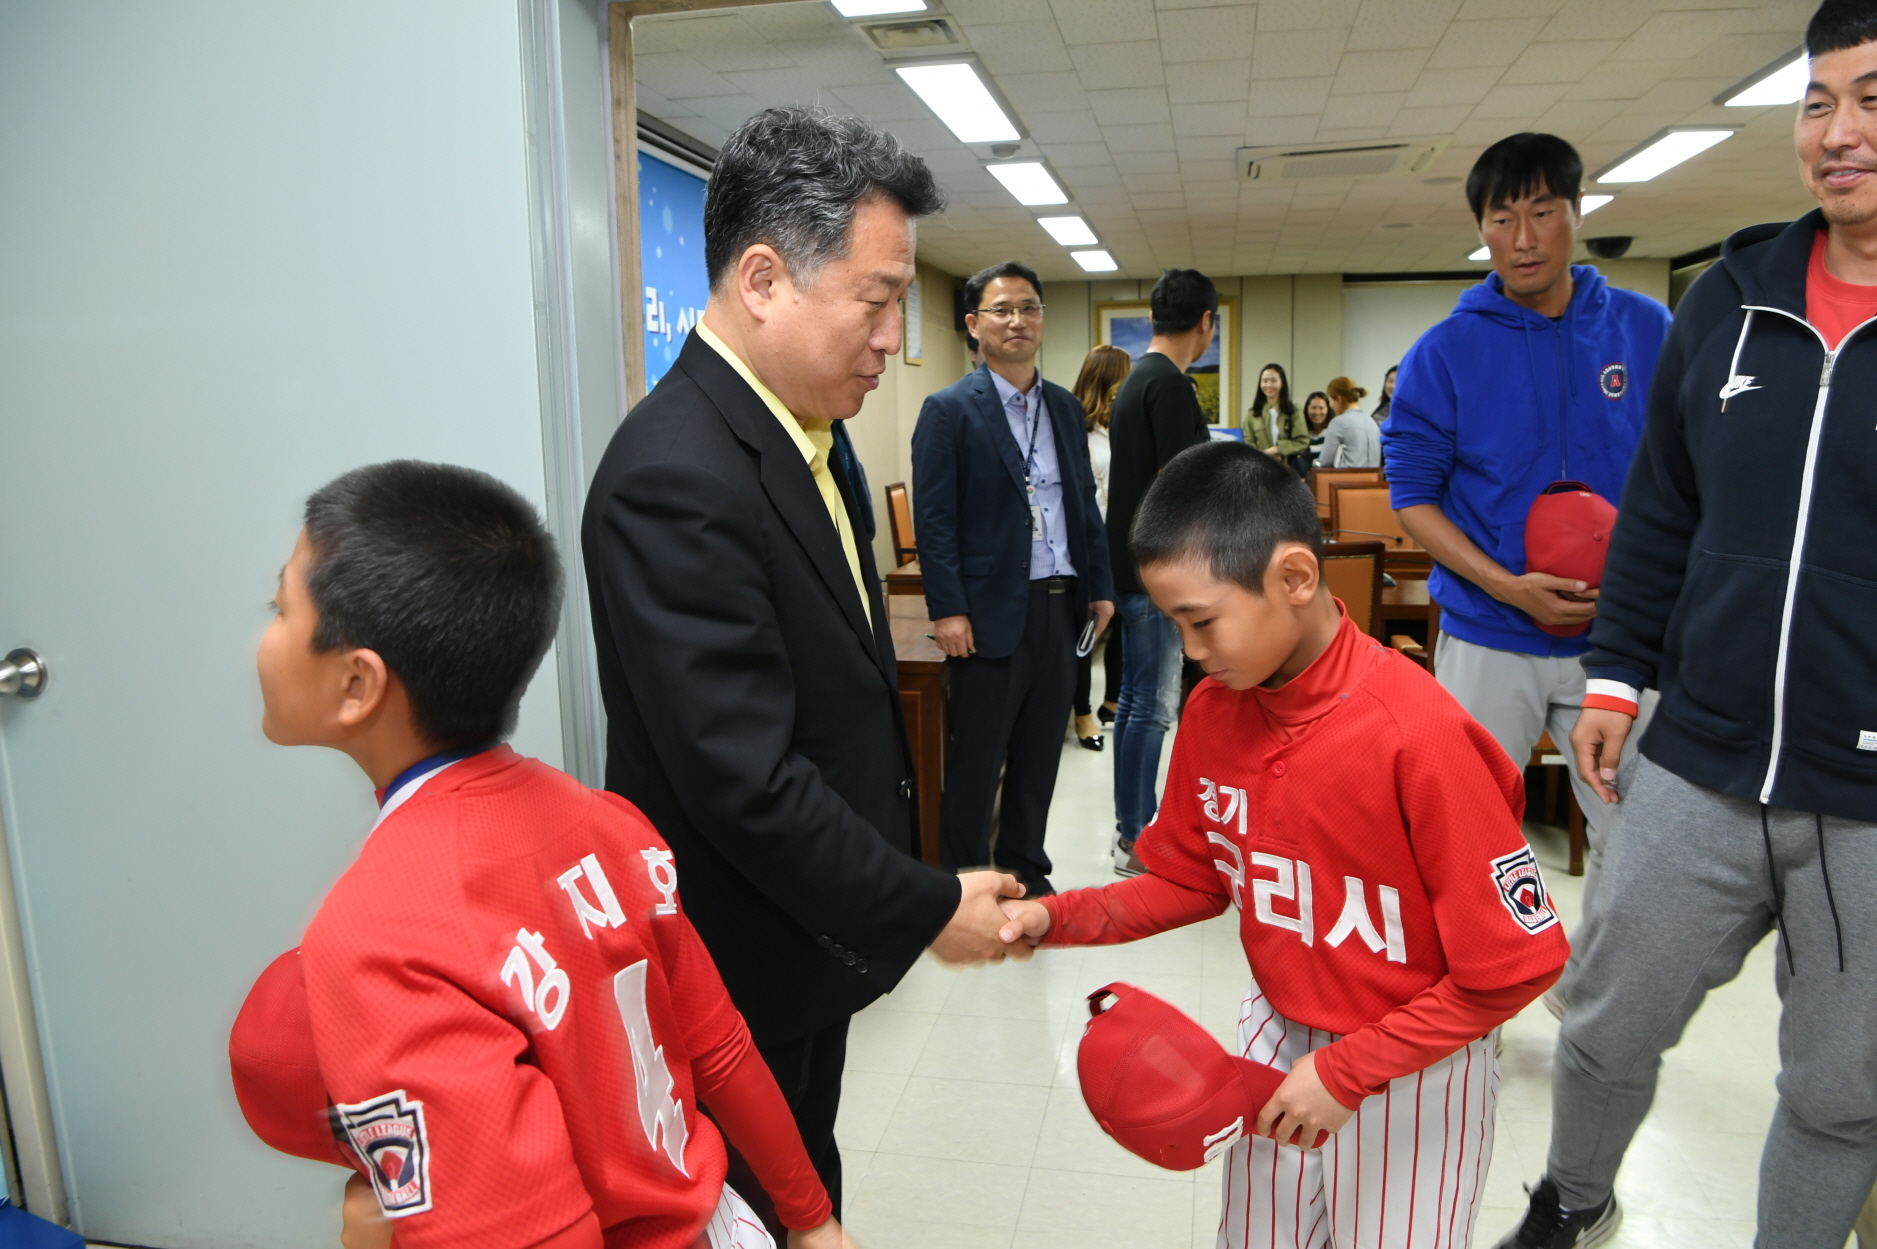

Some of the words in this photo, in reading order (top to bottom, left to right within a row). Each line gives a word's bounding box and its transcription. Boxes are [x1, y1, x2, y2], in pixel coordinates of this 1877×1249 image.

[676, 306, 705, 335] 시
[1197, 777, 1248, 835] 경기
[1206, 831, 1407, 964] 구리시
[375, 1124, 413, 1139] LEAGUE
